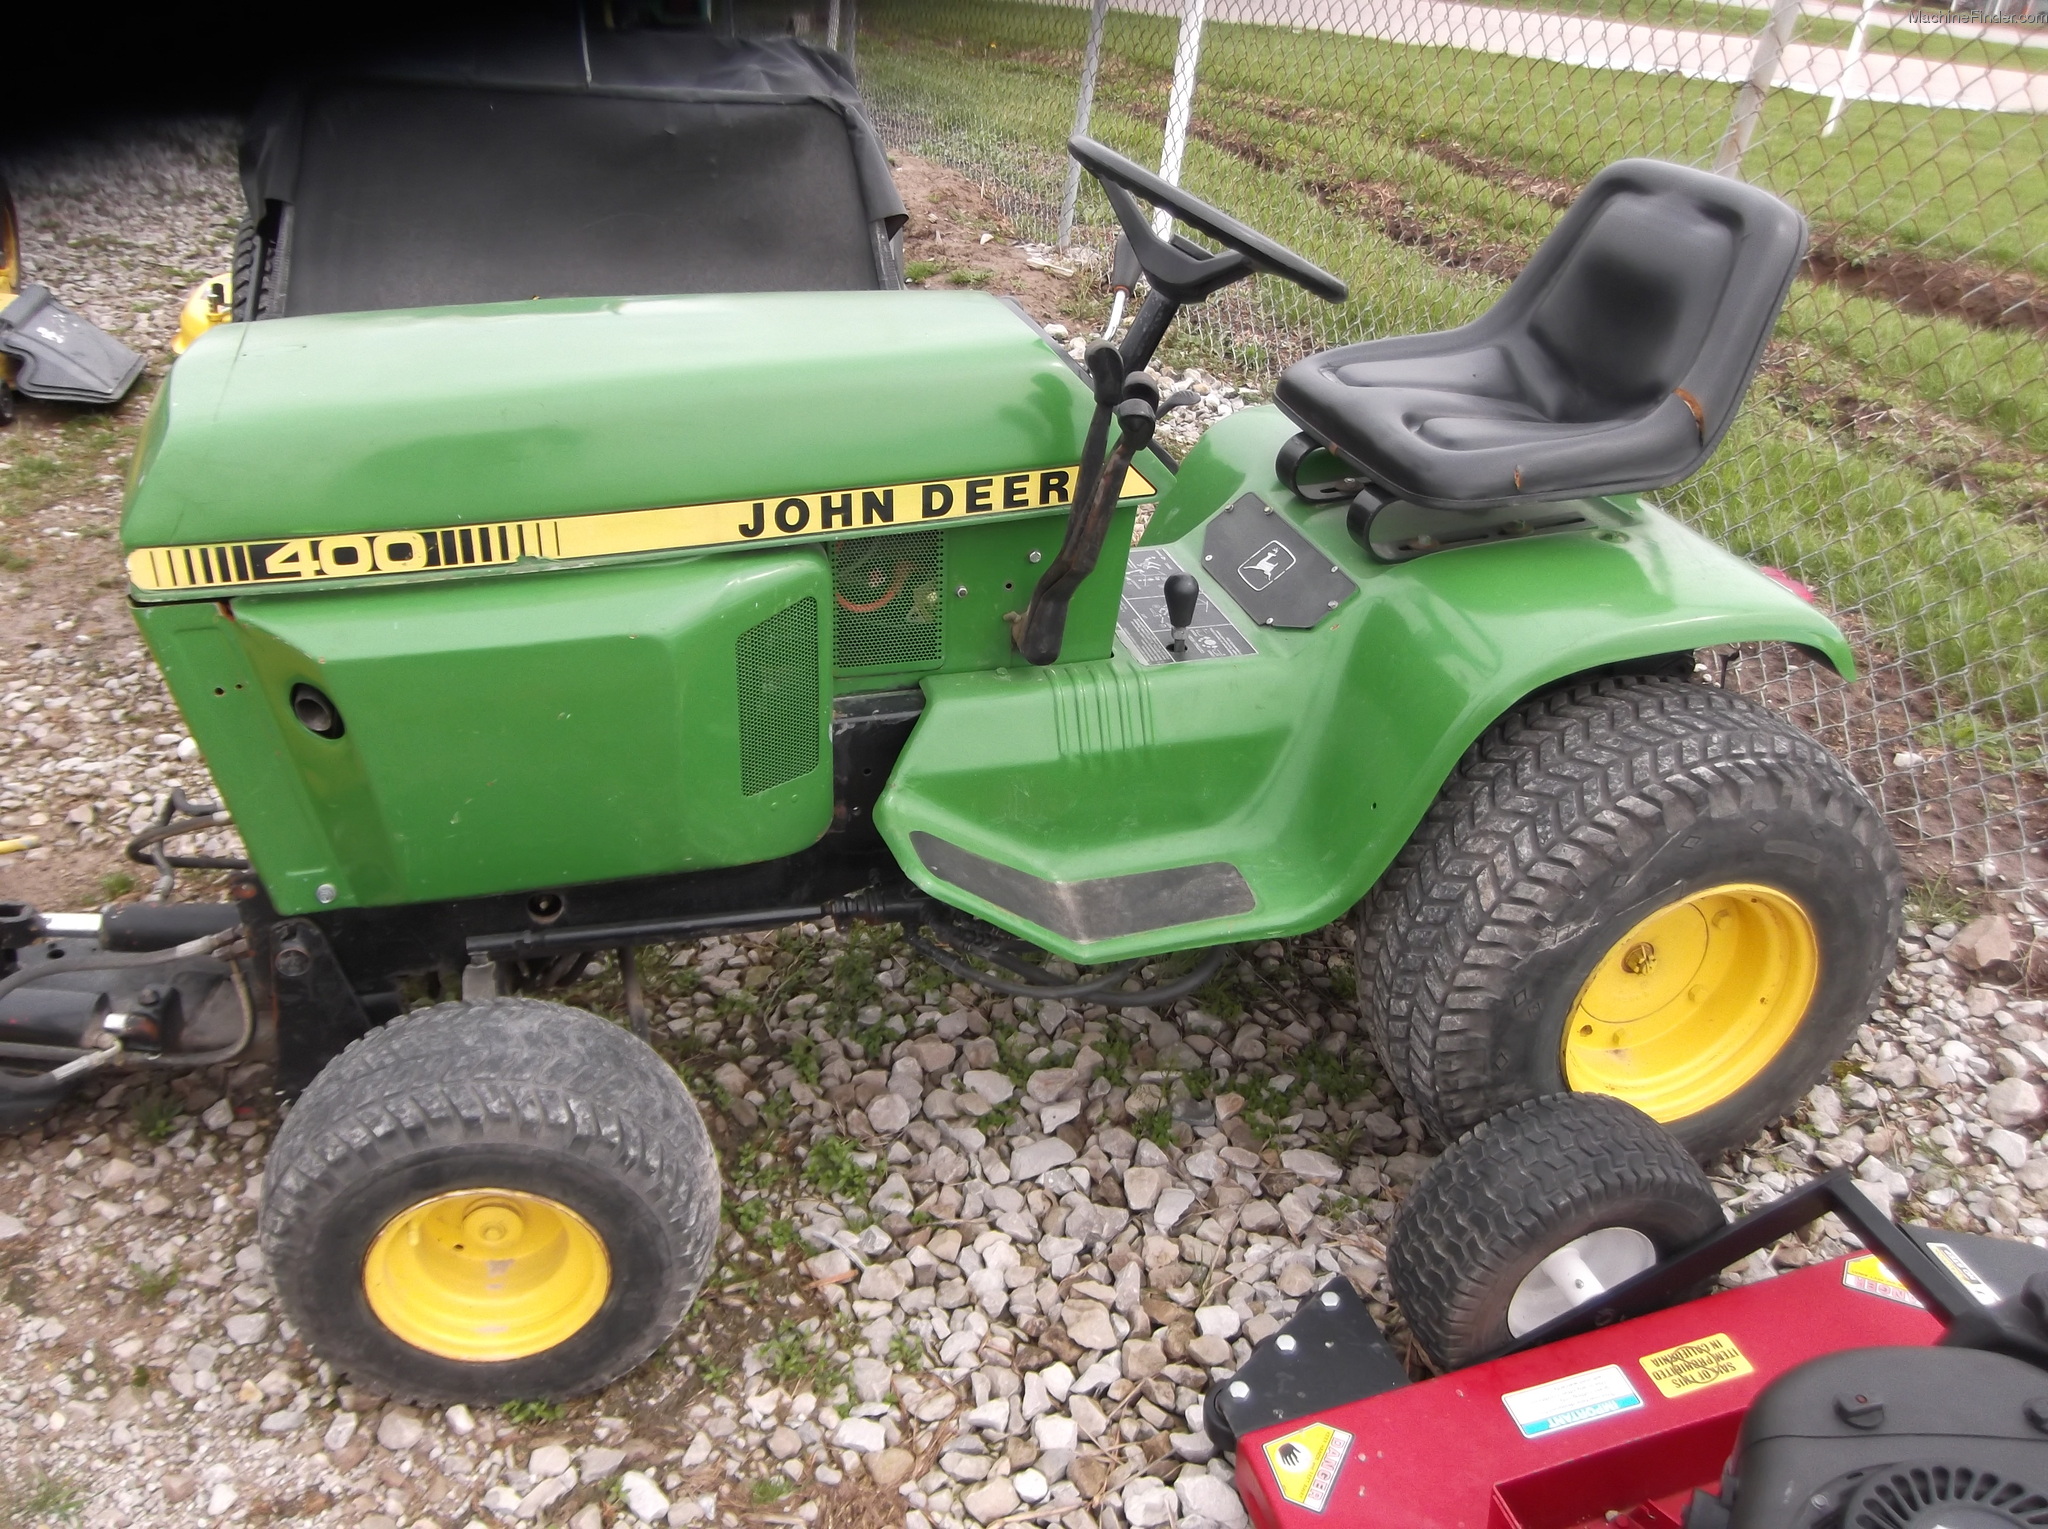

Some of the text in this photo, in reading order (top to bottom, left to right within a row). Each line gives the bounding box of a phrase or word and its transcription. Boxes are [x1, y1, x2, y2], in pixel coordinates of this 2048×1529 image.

[738, 470, 1070, 538] JOHN DEER
[265, 531, 428, 578] 400
[1854, 1276, 1917, 1304] ANGER
[1650, 1339, 1724, 1367] IN CALIFORNIA
[1652, 1348, 1740, 1381] ITEM PROHIBITED
[1697, 1368, 1712, 1381] OF
[1547, 1399, 1620, 1429] IMPORTANT
[1307, 1436, 1346, 1500] DANGER
